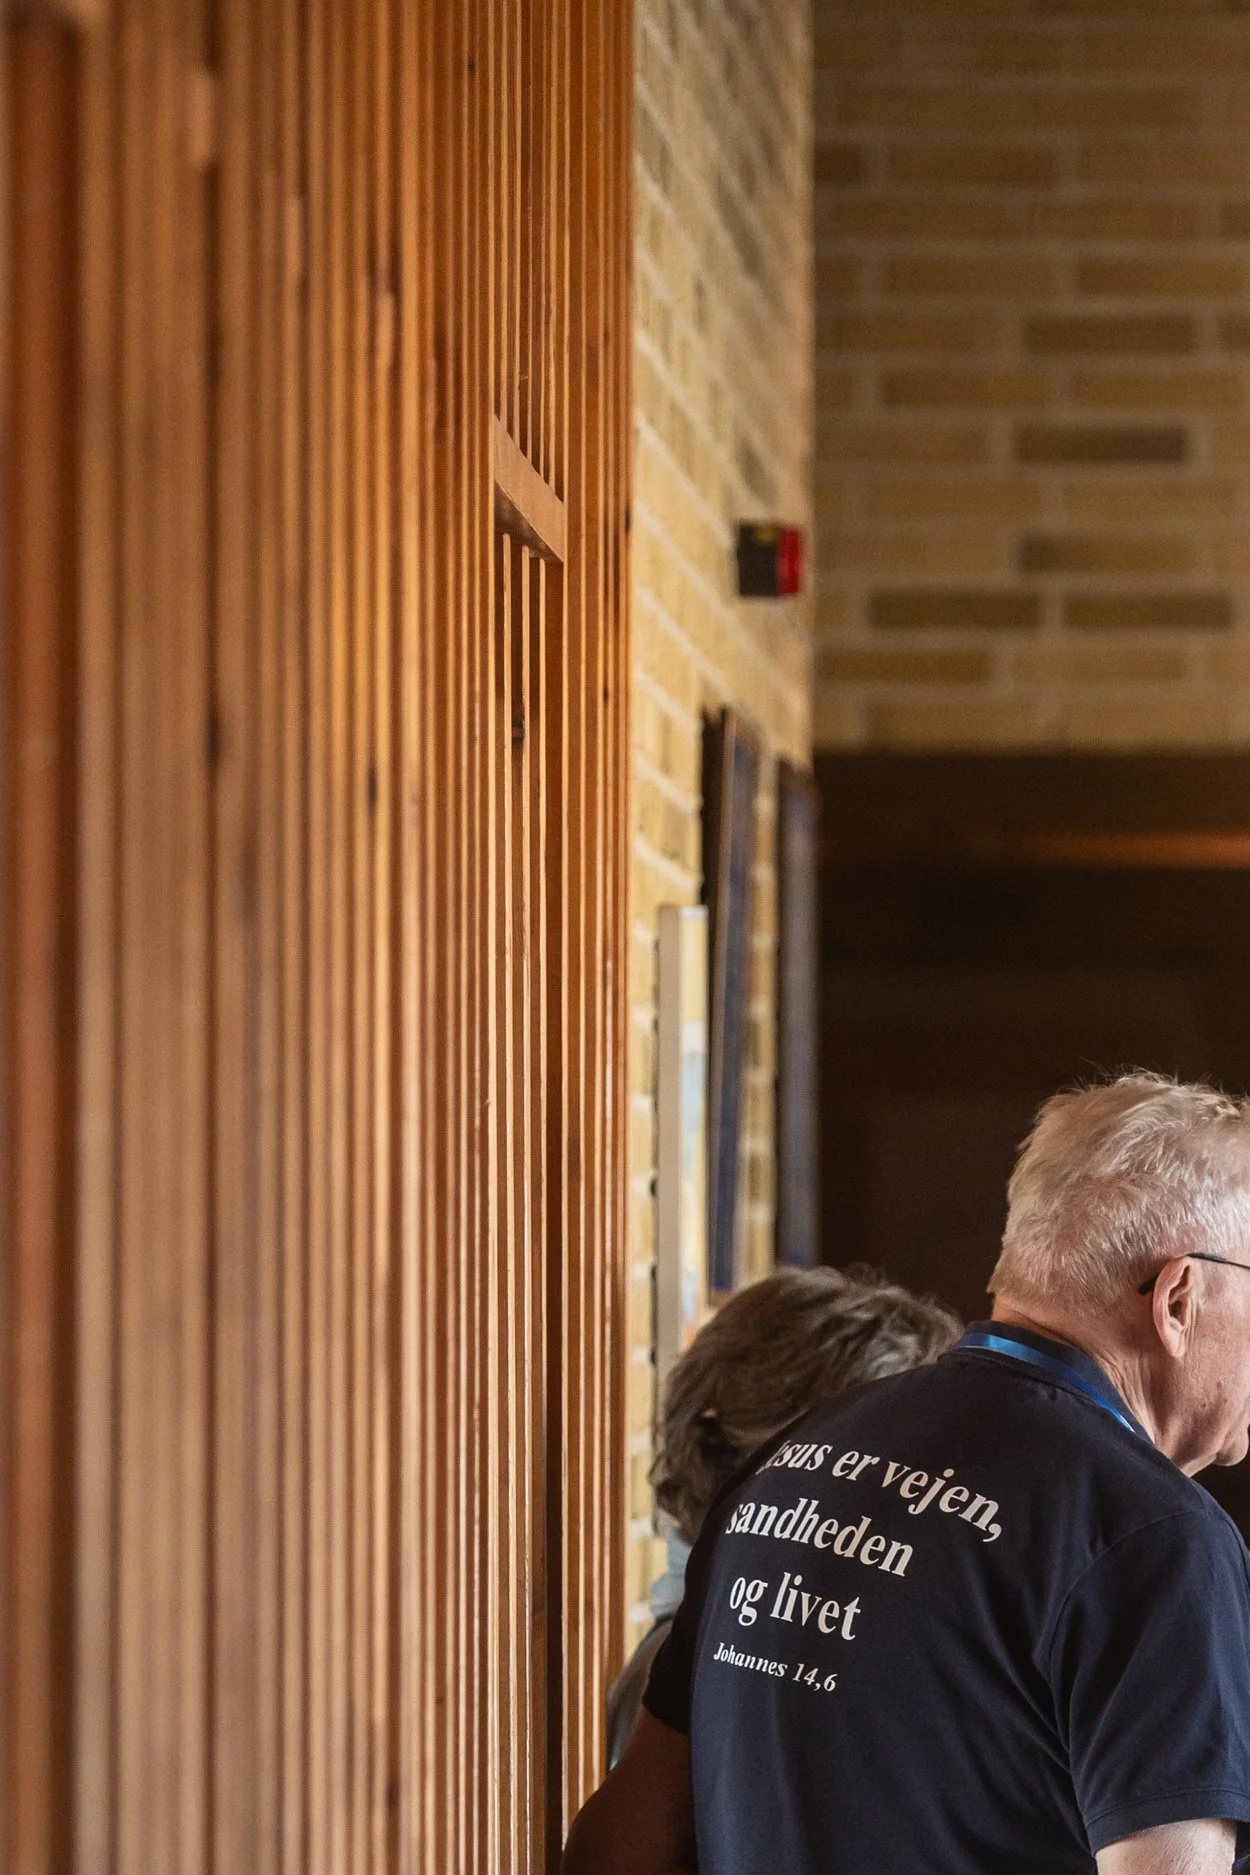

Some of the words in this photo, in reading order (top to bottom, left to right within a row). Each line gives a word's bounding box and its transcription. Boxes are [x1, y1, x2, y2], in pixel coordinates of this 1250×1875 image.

[831, 1450, 880, 1481] er
[881, 1461, 1002, 1543] vejen,
[725, 1497, 914, 1577] sandheden
[729, 1576, 769, 1627] og
[769, 1571, 862, 1641] livet
[713, 1641, 788, 1677] Johannes
[792, 1663, 838, 1692] 14,6
